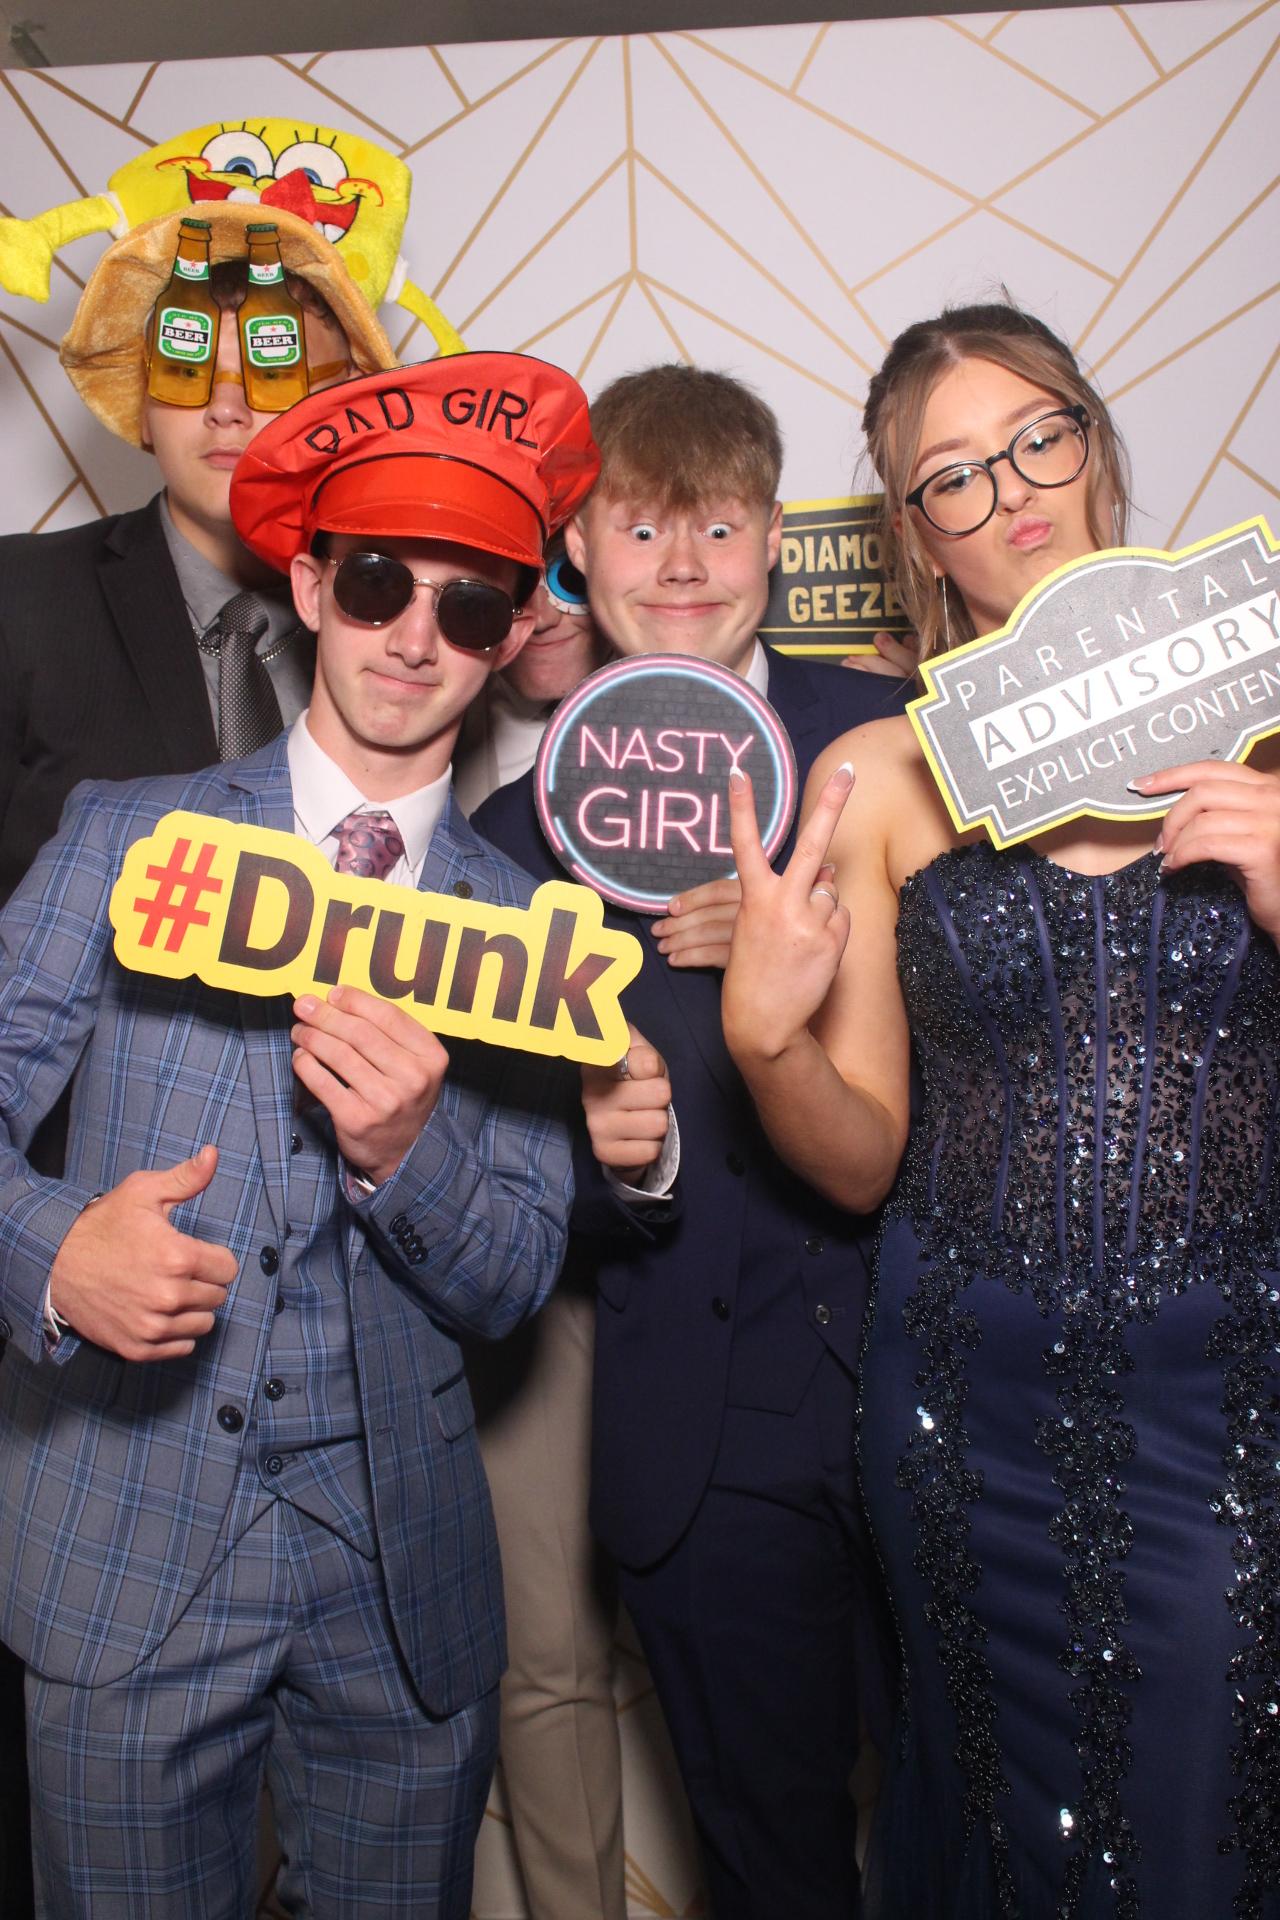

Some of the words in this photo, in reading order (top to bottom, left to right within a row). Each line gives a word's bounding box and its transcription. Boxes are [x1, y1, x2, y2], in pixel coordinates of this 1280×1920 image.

[164, 327, 205, 342] BEER
[252, 336, 294, 347] BEER
[956, 558, 1268, 711] PARENTAL
[983, 597, 1280, 764] ADVISORY
[579, 725, 754, 774] NASTY
[997, 725, 1139, 809] EXPLICIT
[577, 786, 735, 854] GIRL
[133, 837, 618, 1042] #Drunk
